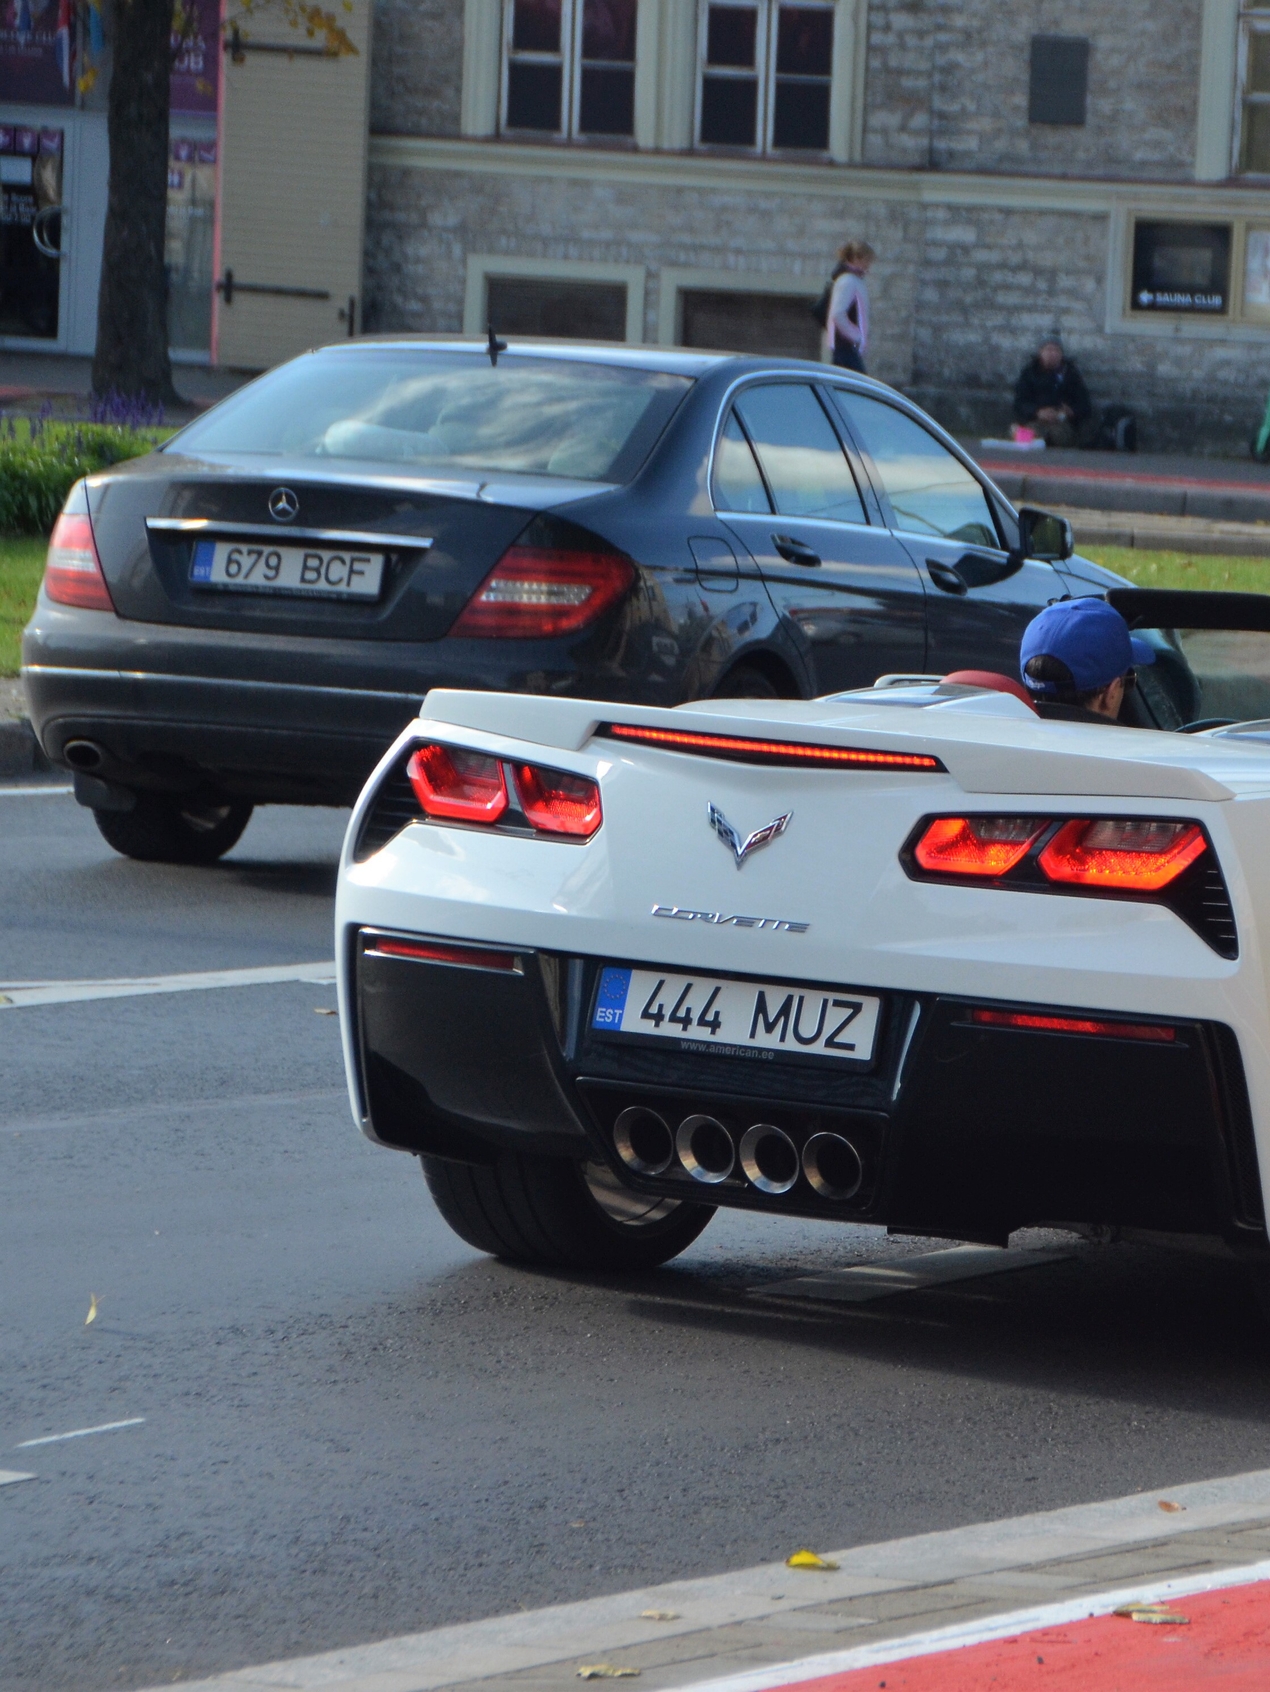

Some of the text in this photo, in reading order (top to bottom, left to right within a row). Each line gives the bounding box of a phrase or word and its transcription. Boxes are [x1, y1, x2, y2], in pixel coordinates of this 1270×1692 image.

[1155, 291, 1223, 305] SAUNA CLUB
[225, 547, 371, 587] 679 BCF
[651, 904, 811, 934] CORVETTE
[596, 1008, 622, 1023] EST
[640, 979, 863, 1052] 444 MUZ
[680, 1040, 775, 1061] www.american.ee
